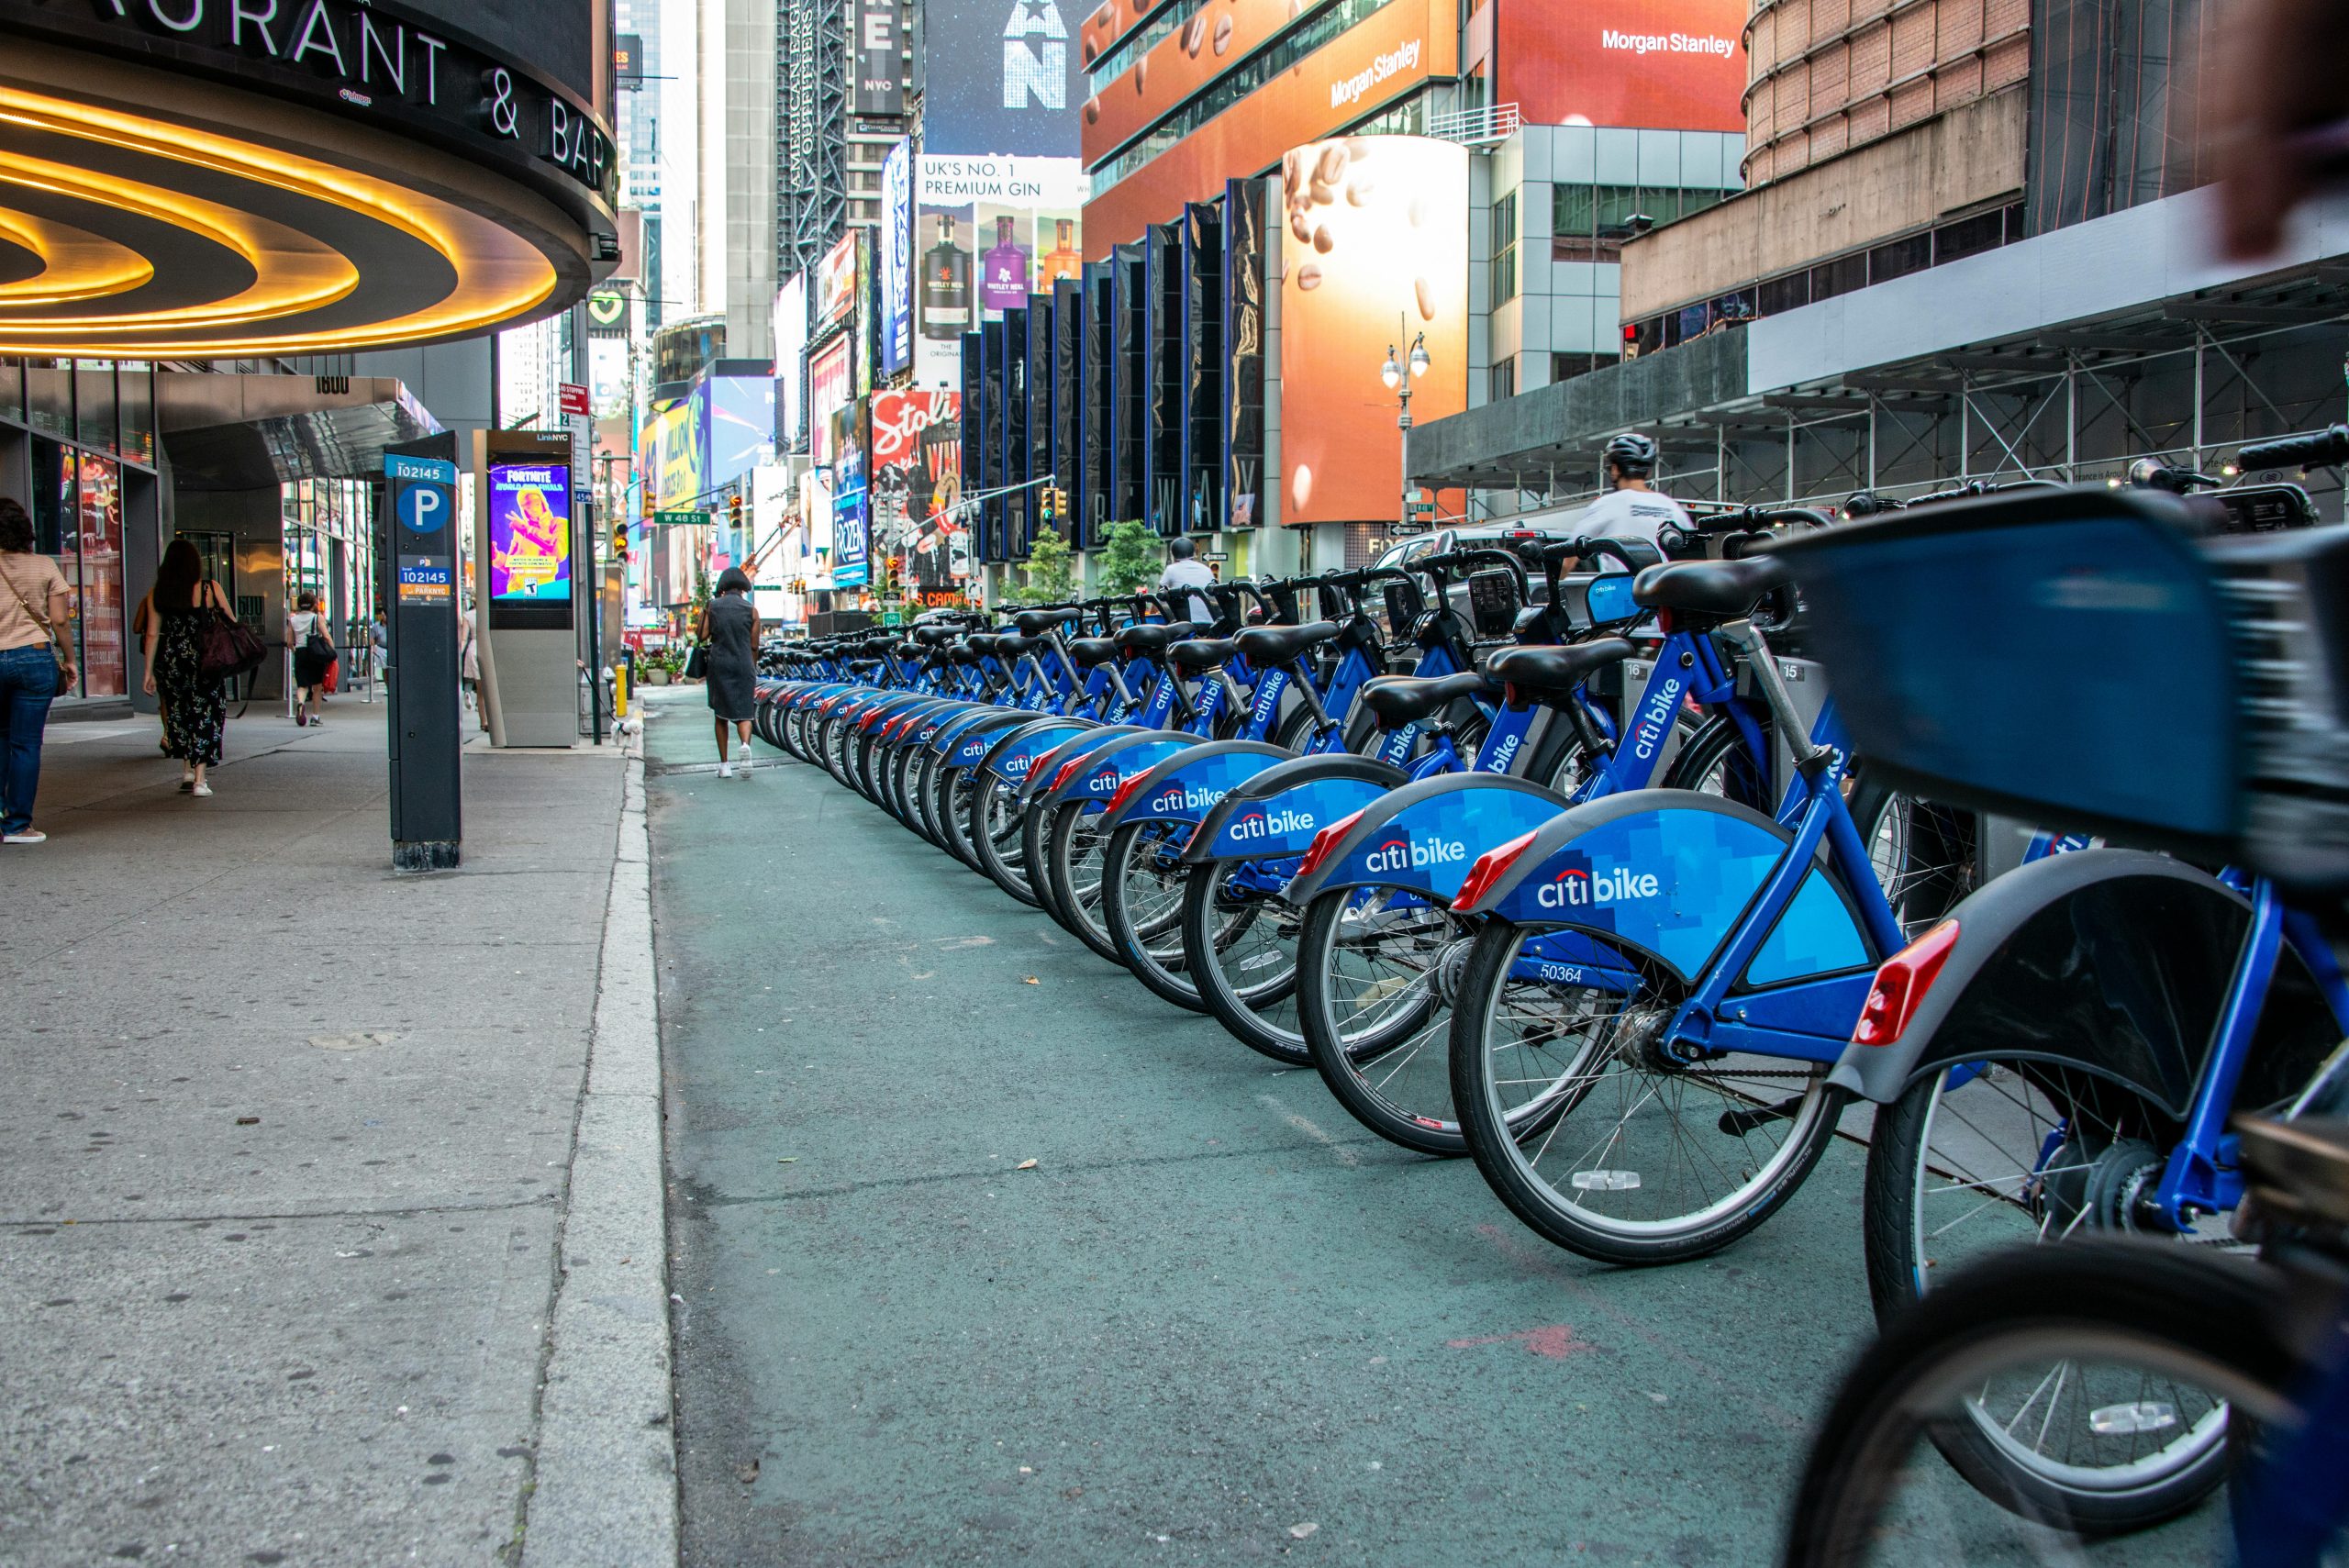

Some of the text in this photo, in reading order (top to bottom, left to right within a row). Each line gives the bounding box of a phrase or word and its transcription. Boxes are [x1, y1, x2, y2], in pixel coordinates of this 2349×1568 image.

[1602, 30, 1735, 59] Morgan Stanley
[802, 9, 814, 155] OUTFITTERS
[1330, 39, 1421, 109] Morgan Stanley
[864, 80, 894, 92] NYC
[493, 67, 520, 139] &
[790, 60, 802, 190] AMERICAN
[925, 161, 1014, 177] UK'S NO. 1
[925, 181, 1041, 196] PREMIUM GIN
[928, 281, 964, 289] WHITLEY NEILL
[987, 283, 1024, 291] WHITLEY NEILL
[872, 383, 958, 455] Stoli
[396, 465, 440, 480] 102145
[507, 470, 551, 484] FORTNITE
[415, 489, 440, 526] P
[664, 514, 701, 523] W 48 St
[834, 514, 863, 562] FROZEN
[404, 572, 446, 584] 102145
[415, 587, 446, 595] PARKNYC
[526, 583, 536, 594] T
[1627, 664, 1640, 676] 16
[1784, 664, 1797, 678] 15
[1264, 672, 1283, 701] bike
[1635, 678, 1680, 760] citi bike
[963, 743, 984, 757] citi
[1388, 722, 1416, 760] bike
[1006, 757, 1029, 772] citi
[1486, 734, 1519, 775] bike
[1089, 774, 1117, 792] citi
[1152, 787, 1226, 813] citi bike
[1230, 810, 1314, 840] citi bike
[1365, 838, 1465, 873] citi bike
[1537, 867, 1659, 908] citi bike
[1541, 963, 1582, 983] 50364
